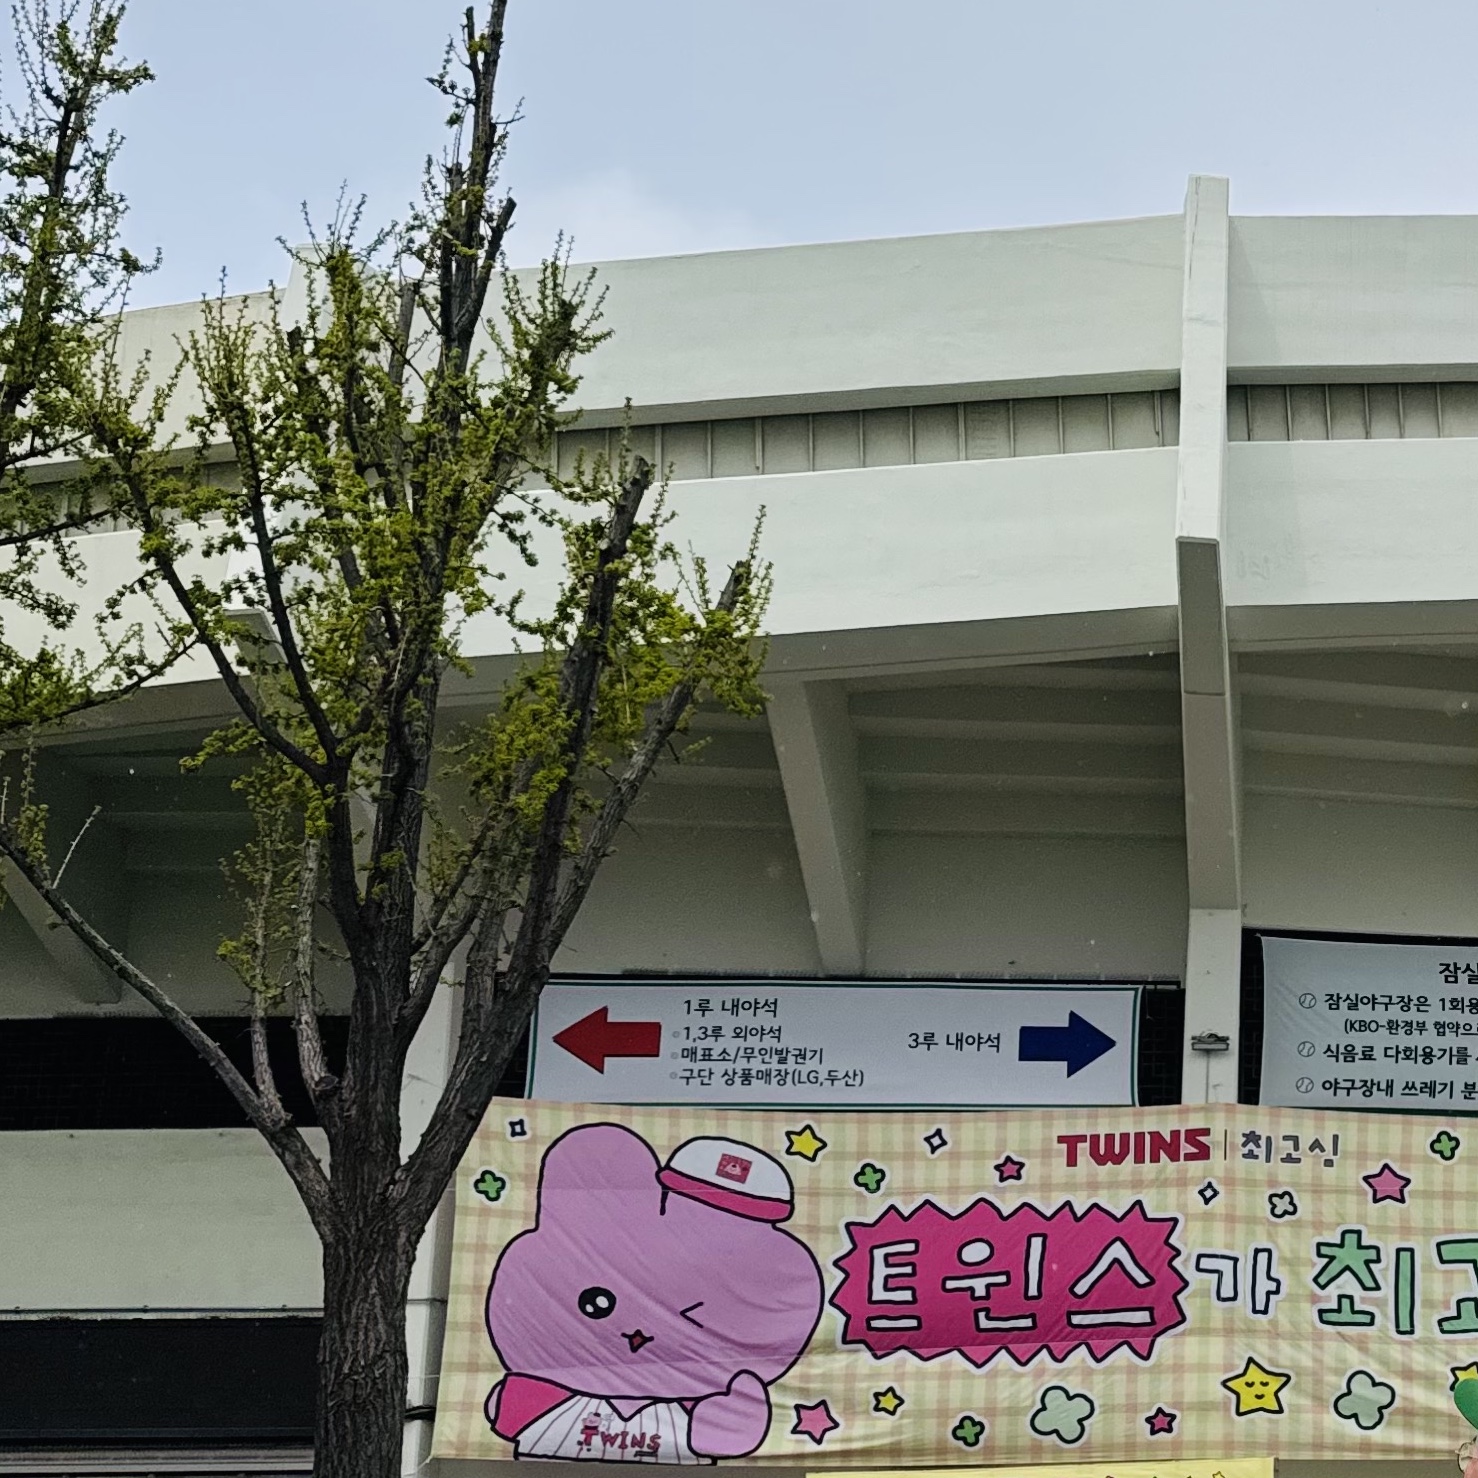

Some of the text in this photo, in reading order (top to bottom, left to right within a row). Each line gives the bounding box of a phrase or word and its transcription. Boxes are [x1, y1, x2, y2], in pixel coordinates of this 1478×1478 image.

[683, 998, 778, 1018] 1루 내야석
[1324, 993, 1431, 1013] 잠실야구장은
[683, 1025, 782, 1043] 1,3루 외야석
[1344, 1018, 1428, 1036] (KBO-환경부
[908, 1032, 1000, 1053] 3루 내야석
[681, 1047, 824, 1065] 매표소/무인발권기
[1323, 1044, 1377, 1063] 식음료
[1384, 1045, 1472, 1066] 다회용기를
[679, 1067, 864, 1087] 구단 상품매장(LG,두산)
[1322, 1078, 1394, 1098] 야구장내
[1401, 1080, 1454, 1099] 쓰레기
[1057, 1127, 1211, 1167] TWINS
[1241, 1130, 1339, 1168] 최고심
[580, 1427, 662, 1451] TWINS
